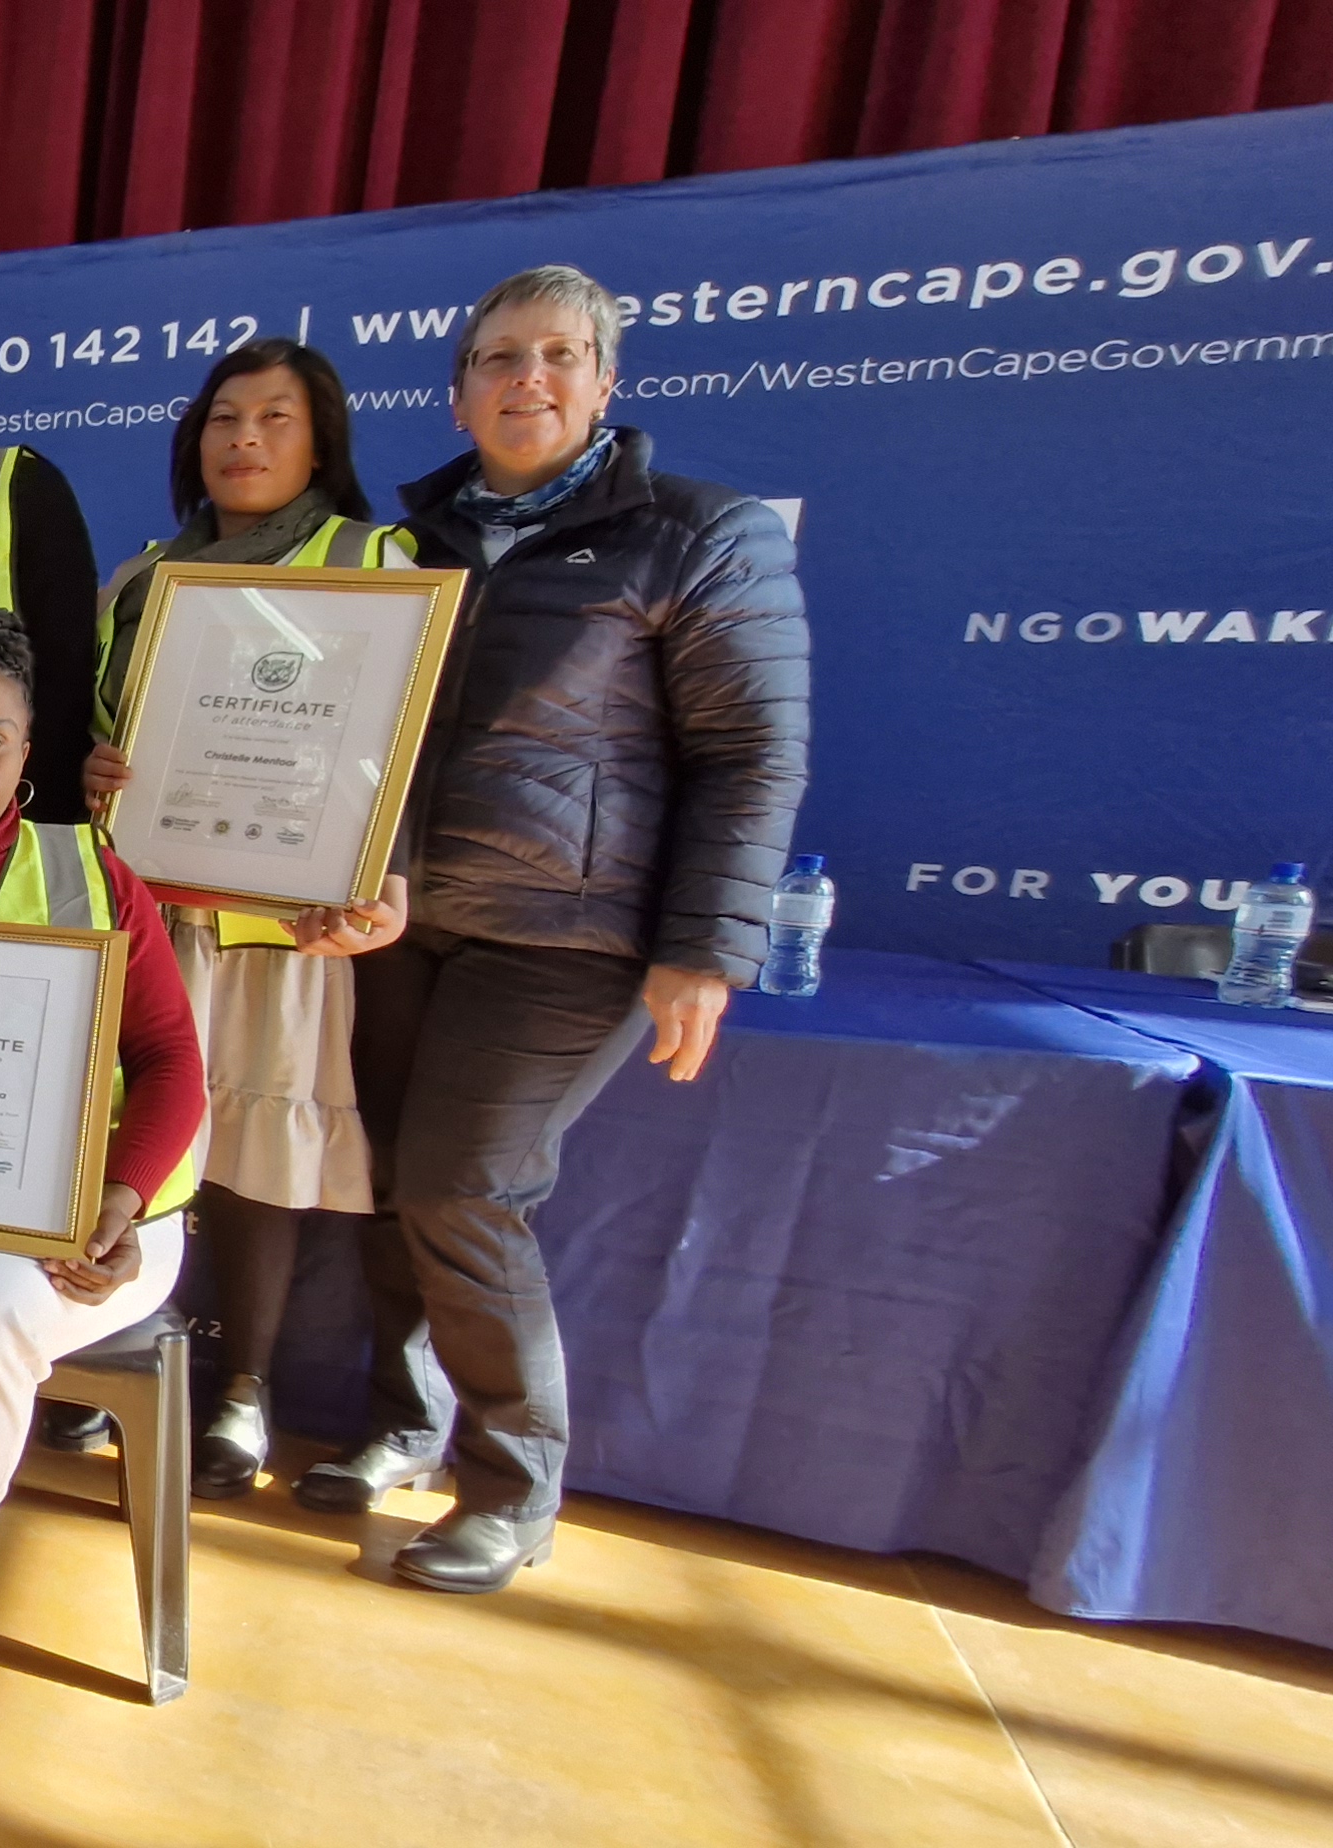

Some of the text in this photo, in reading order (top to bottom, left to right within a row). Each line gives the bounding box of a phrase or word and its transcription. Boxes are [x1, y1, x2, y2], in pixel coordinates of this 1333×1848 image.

[50, 325, 141, 369] 142
[161, 315, 258, 359] 142
[963, 609, 1333, 644] NGOWAK
[199, 694, 336, 718] CERTIFICATE
[212, 714, 312, 732] of attendance
[204, 750, 251, 764] Christelle
[905, 862, 1252, 912] FOR YOU
